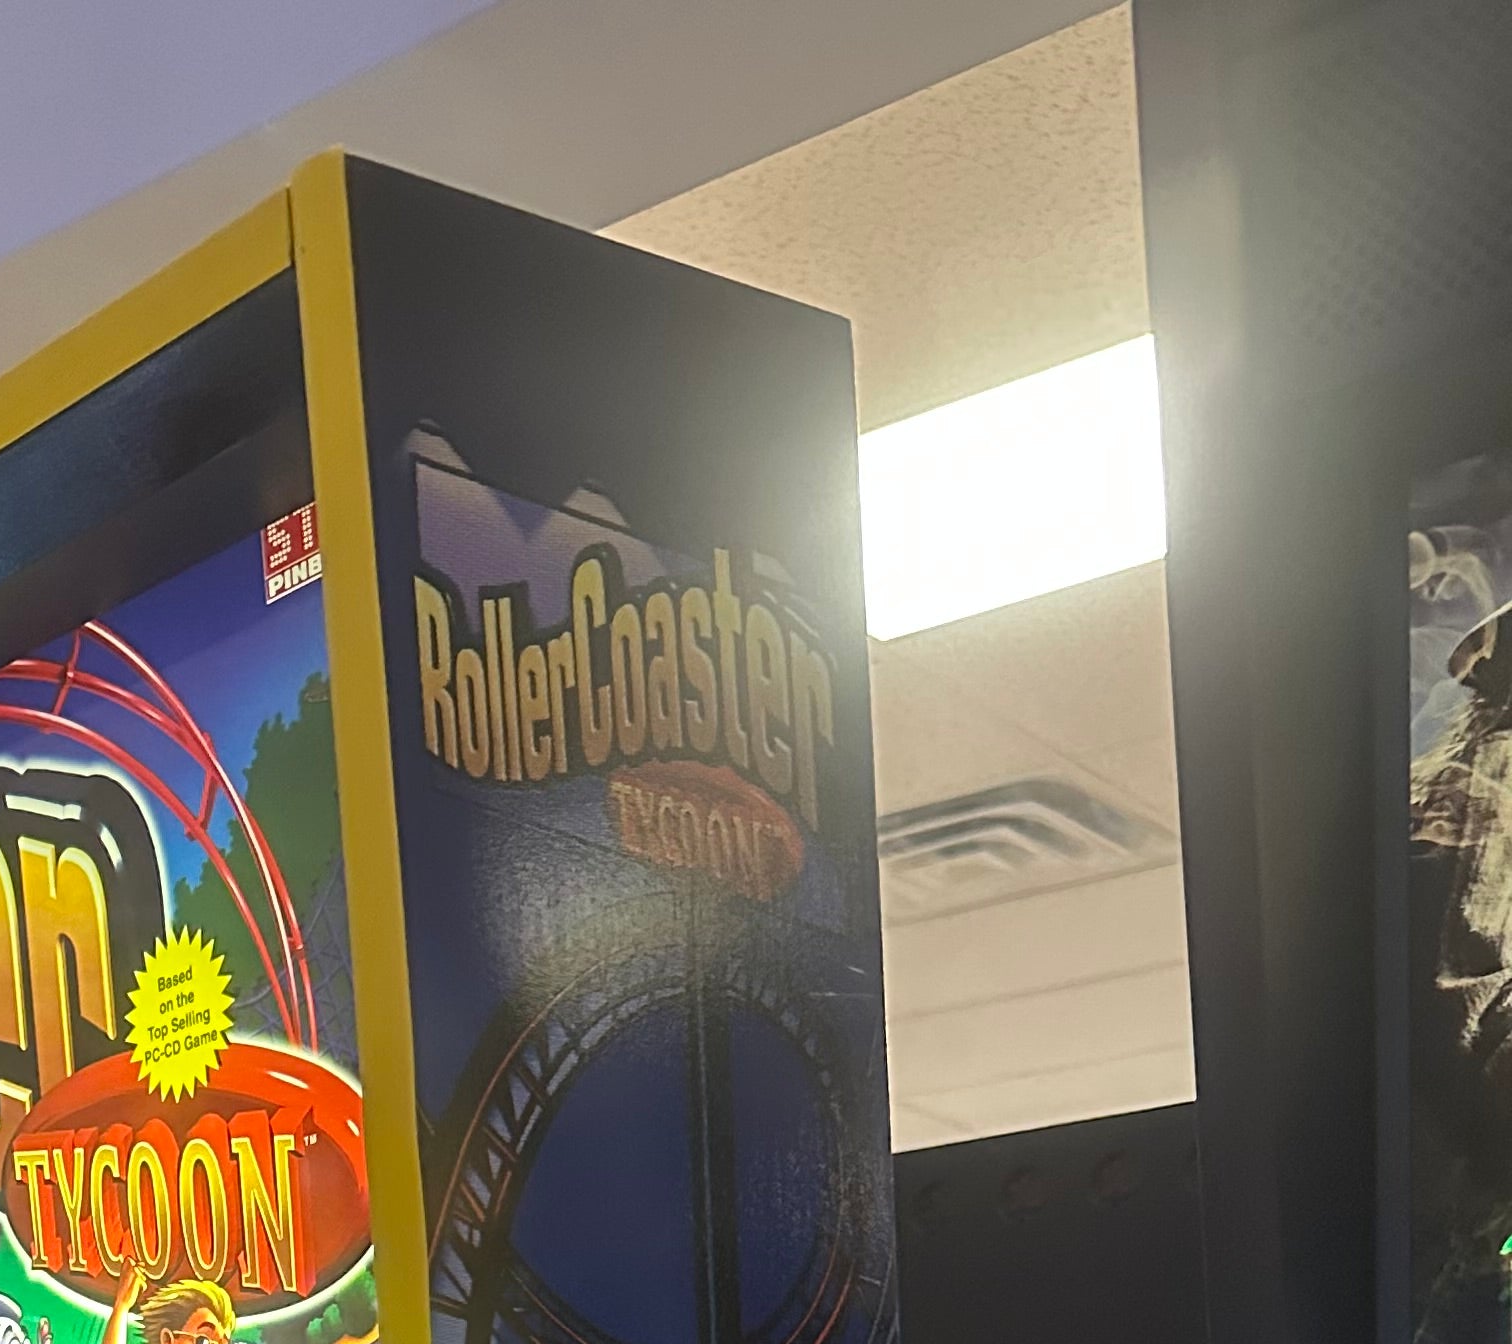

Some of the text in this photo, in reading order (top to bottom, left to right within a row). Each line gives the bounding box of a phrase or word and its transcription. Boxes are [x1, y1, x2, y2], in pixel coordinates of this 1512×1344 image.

[413, 548, 835, 832] RollerCoaster
[611, 780, 764, 900] TYCOON
[157, 964, 194, 993] Based
[159, 991, 195, 1015] on the
[147, 1008, 211, 1042] Top Selling
[144, 1029, 218, 1066] PC-CD Game
[13, 1132, 299, 1293] TYCOON
